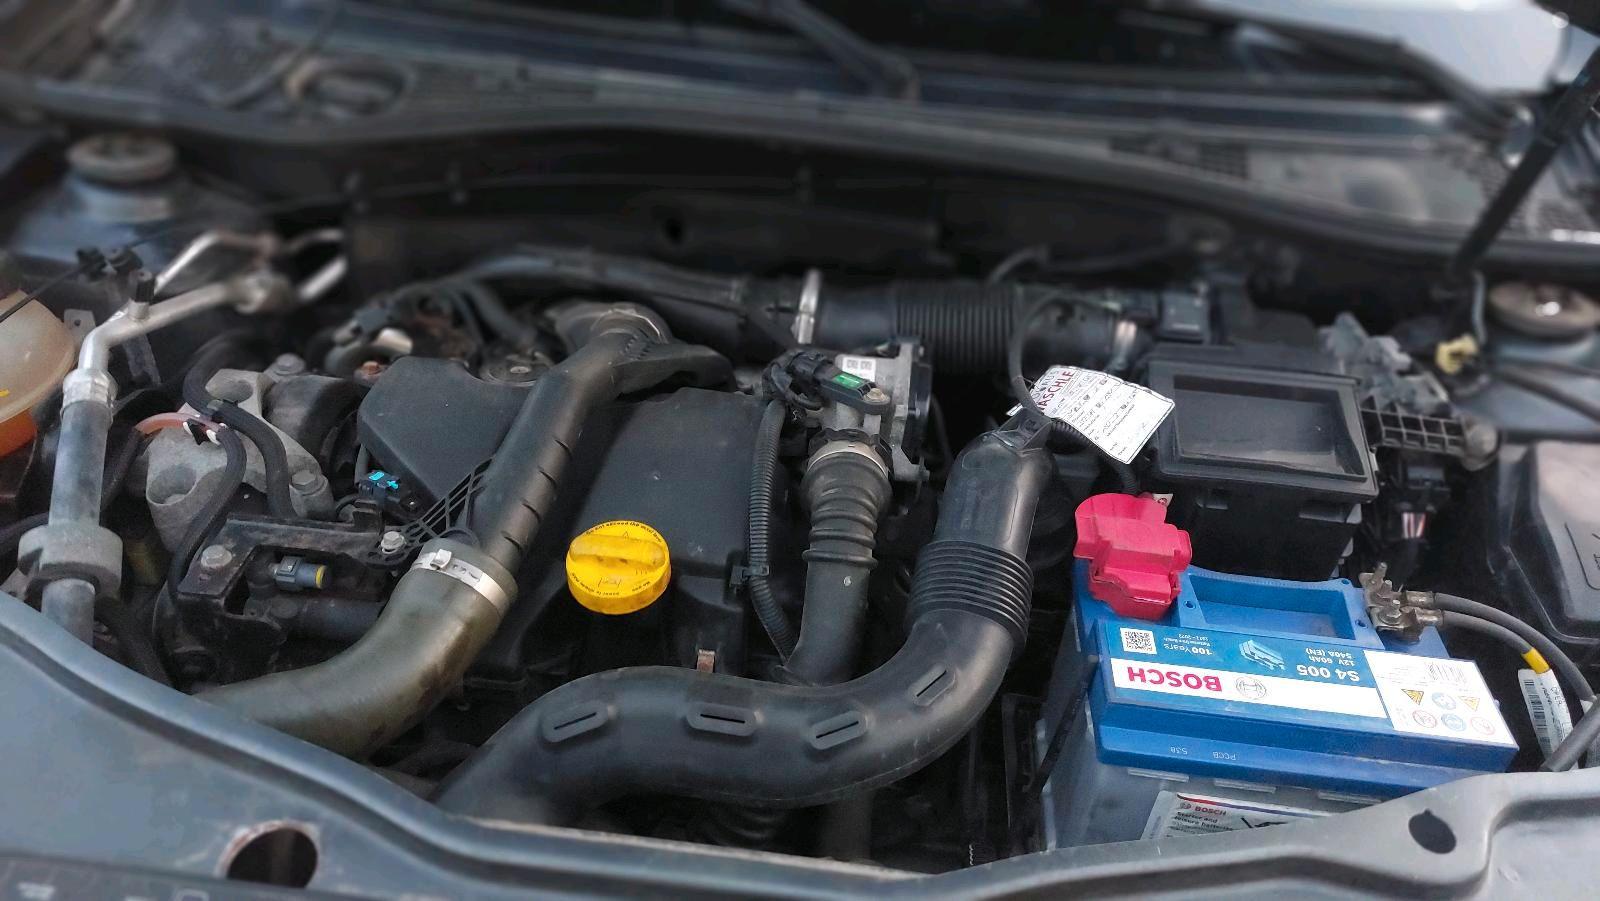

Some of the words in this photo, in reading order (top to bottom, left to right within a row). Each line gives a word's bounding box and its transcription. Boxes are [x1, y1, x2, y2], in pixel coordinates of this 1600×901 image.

[1163, 643, 1192, 654] Years
[1191, 646, 1213, 656] 100
[1305, 647, 1326, 657] (EN)
[1308, 655, 1333, 664] 60Ah
[1327, 650, 1352, 659] 540A
[1338, 659, 1356, 667] 12V
[1296, 664, 1331, 679] 005
[1335, 668, 1360, 682] S4
[1127, 666, 1222, 692] BOSCH
[1194, 806, 1227, 816] BOSCH
[1177, 811, 1203, 820] Starter
[1203, 816, 1219, 824] and
